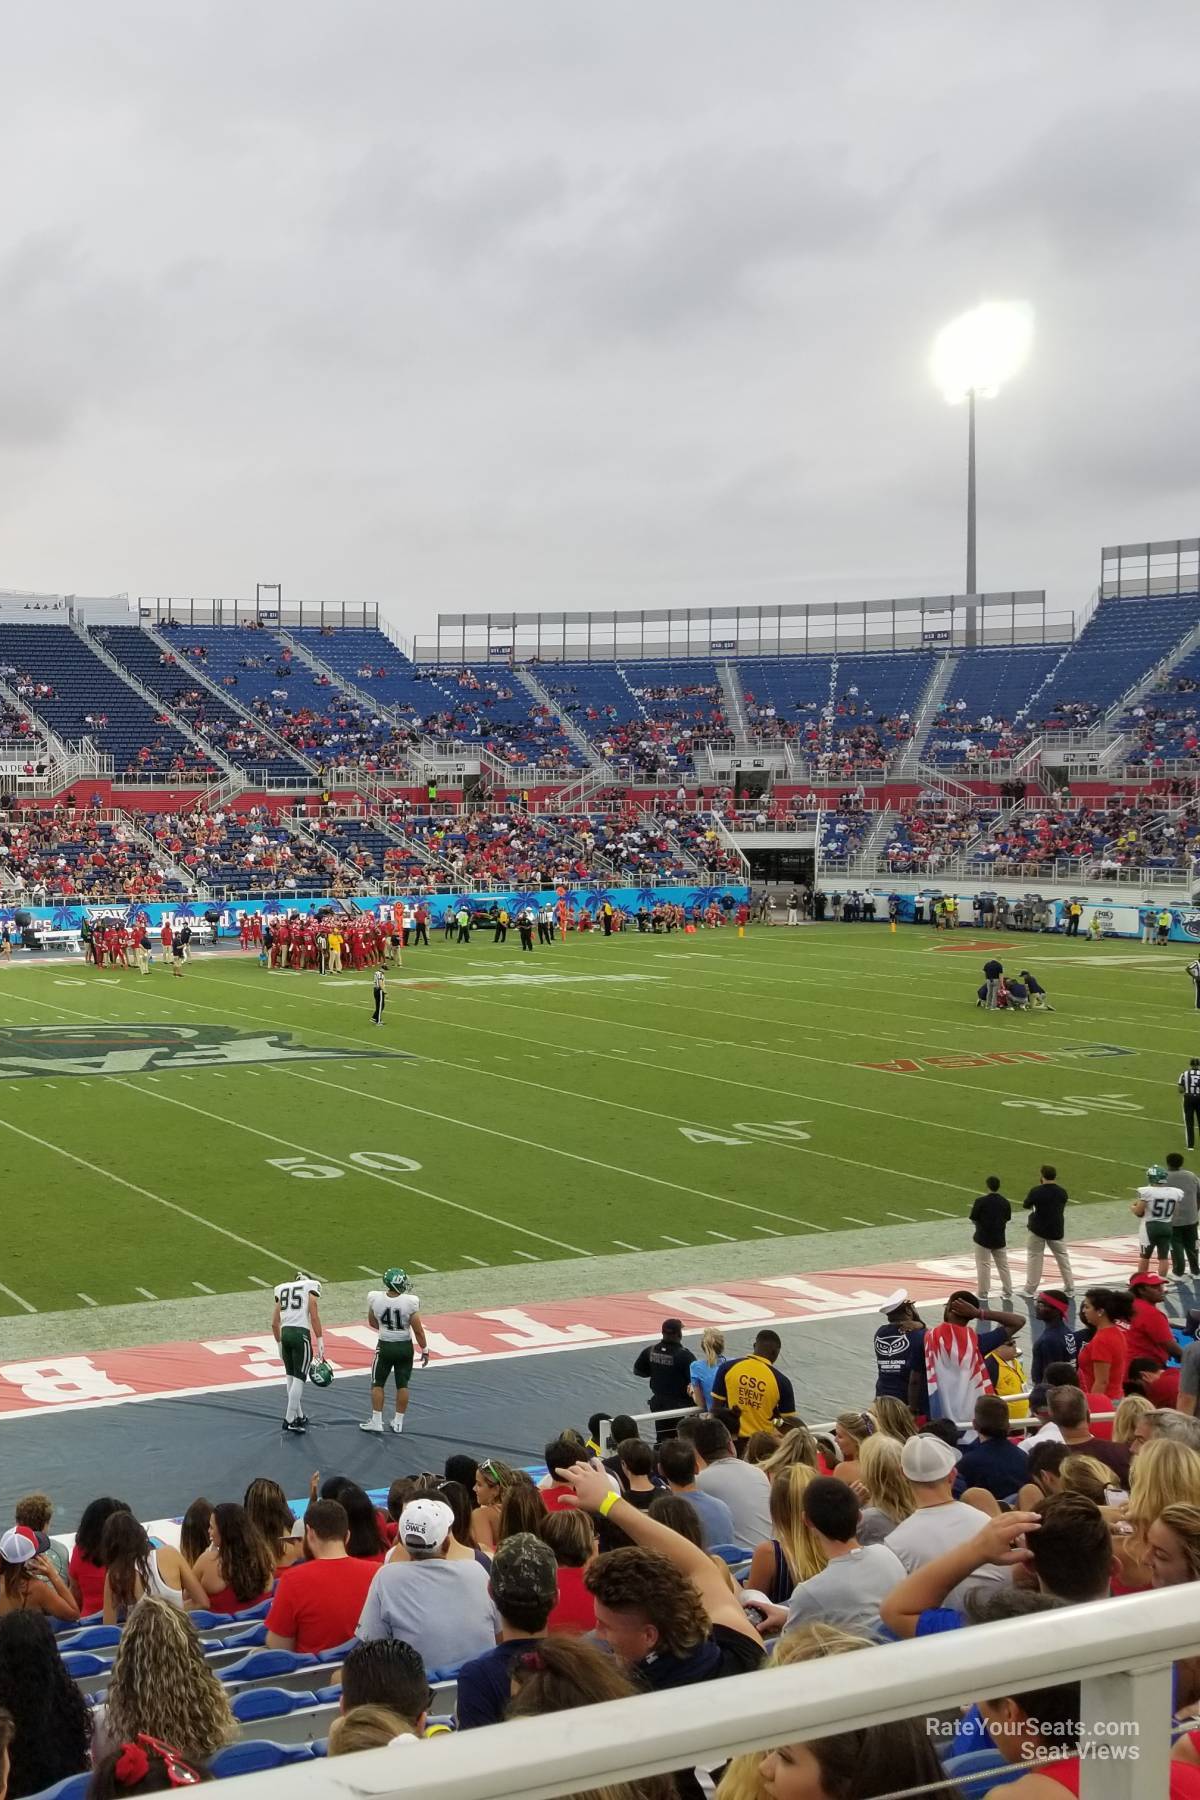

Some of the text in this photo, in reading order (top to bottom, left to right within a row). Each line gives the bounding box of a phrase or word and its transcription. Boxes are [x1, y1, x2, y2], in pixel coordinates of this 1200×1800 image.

[161, 910, 230, 928] Howad
[1152, 1198, 1176, 1217] 50
[280, 1287, 304, 1310] 85
[646, 1276, 895, 1323] TO
[381, 1307, 404, 1331] 41
[739, 1374, 767, 1392] CSC
[738, 1387, 765, 1402] EVENT
[738, 1396, 762, 1411] STAFF
[405, 1525, 426, 1535] OWLS
